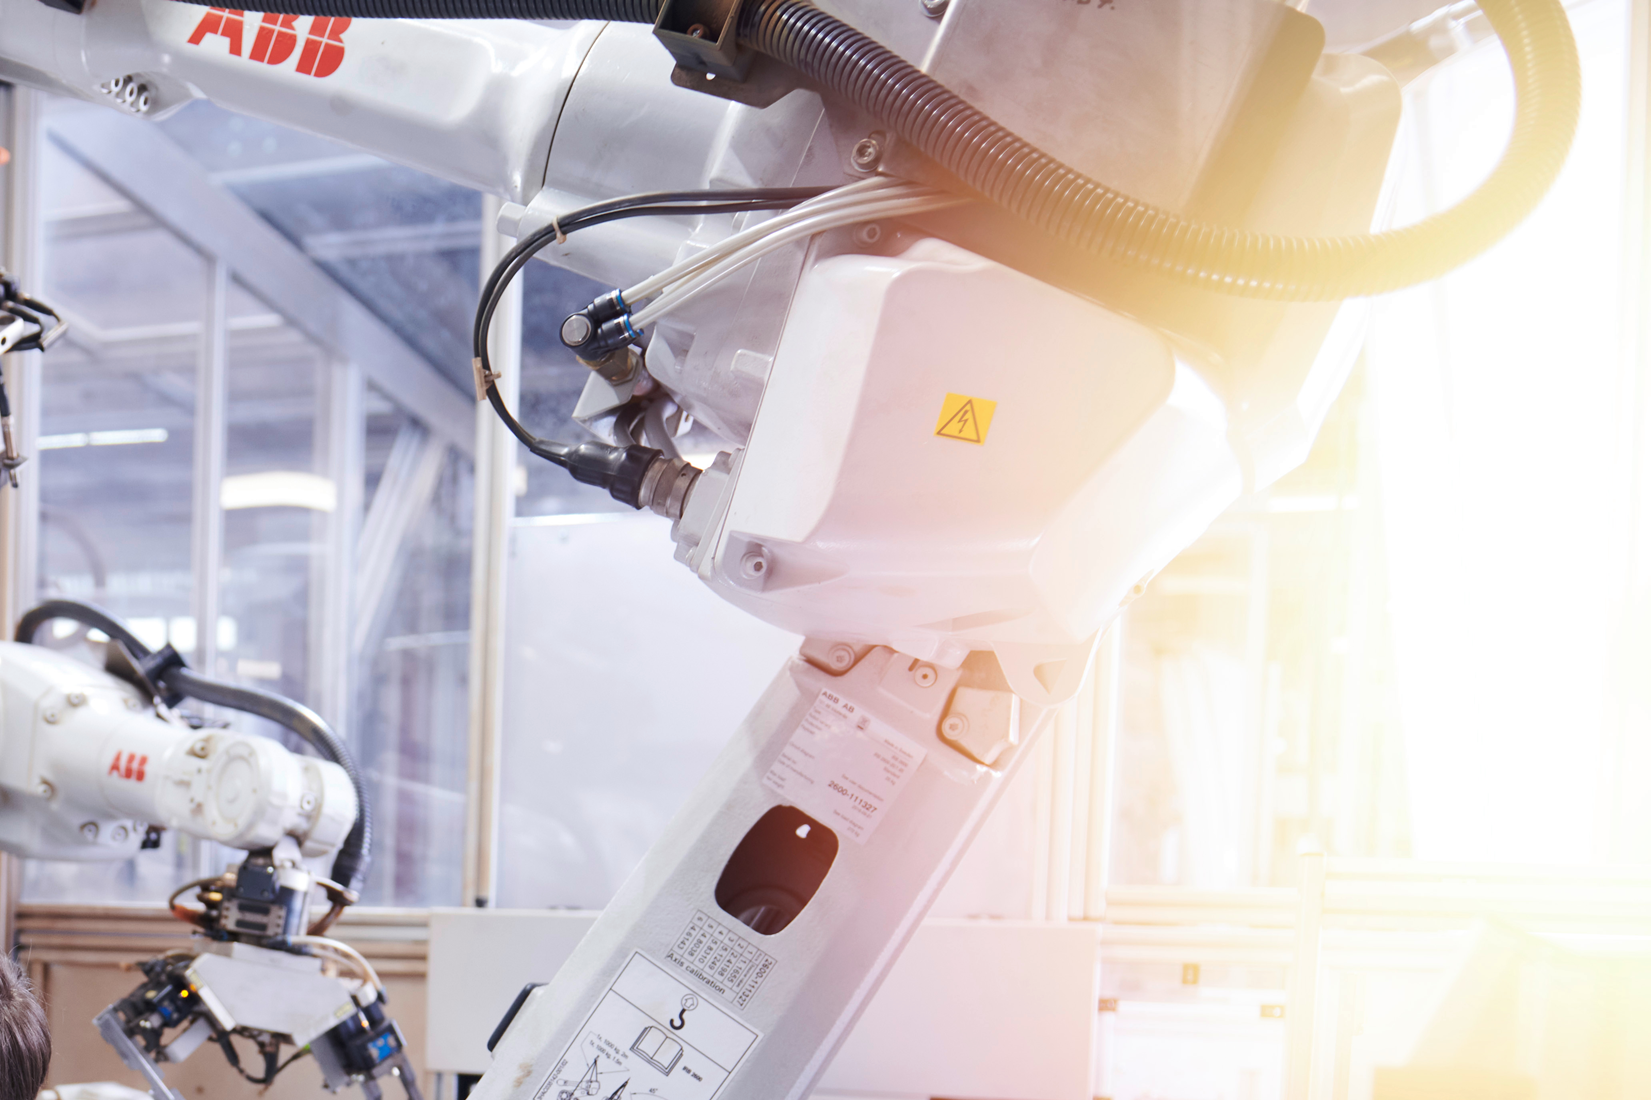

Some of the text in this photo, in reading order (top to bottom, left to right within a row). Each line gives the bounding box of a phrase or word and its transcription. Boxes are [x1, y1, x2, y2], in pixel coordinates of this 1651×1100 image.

[187, 6, 353, 78] ABB
[822, 691, 839, 704] ABB
[843, 703, 854, 713] AB
[108, 750, 149, 783] ABB
[828, 780, 877, 813] 2600-111327
[678, 925, 696, 950] 4.6143
[688, 932, 707, 957] 4.8038
[698, 939, 717, 964] 5.8310
[708, 945, 728, 970] 5.1249
[667, 952, 726, 994] Axis calibration
[718, 952, 737, 977] 2.4198
[727, 958, 746, 983] 1.1655
[737, 959, 772, 1007] 2600-111327
